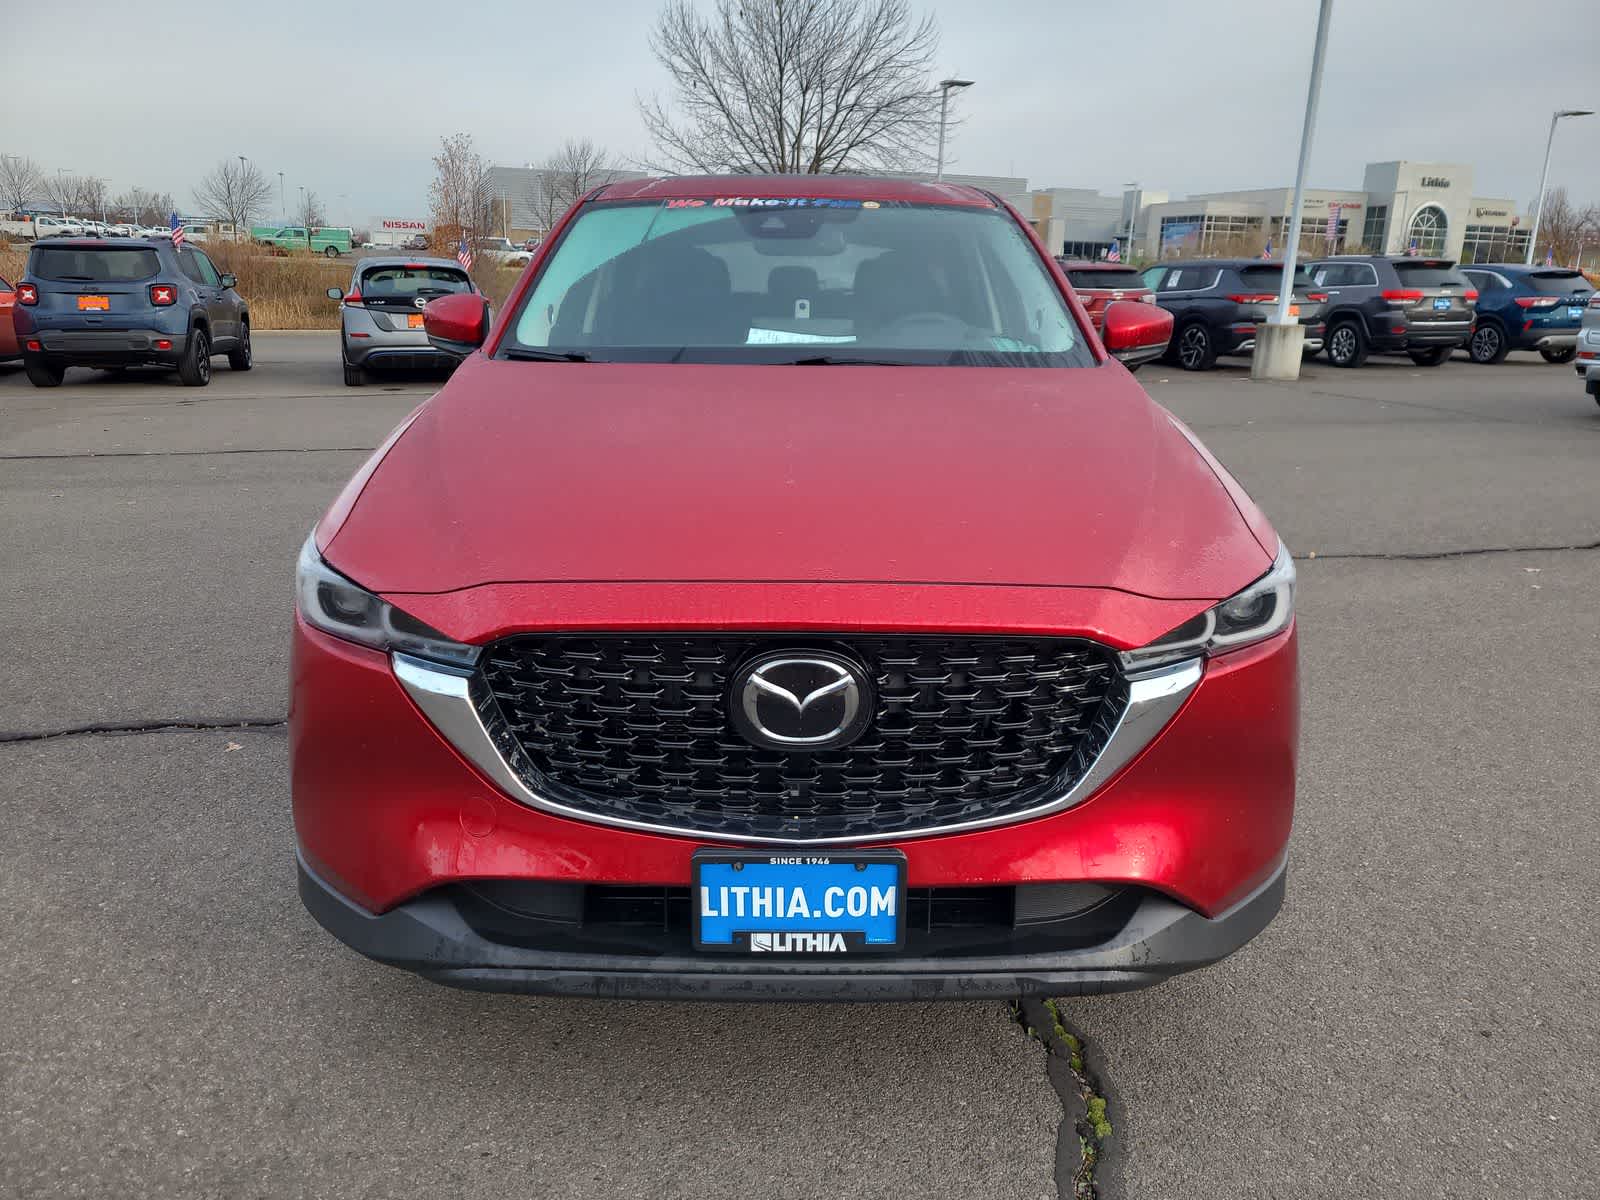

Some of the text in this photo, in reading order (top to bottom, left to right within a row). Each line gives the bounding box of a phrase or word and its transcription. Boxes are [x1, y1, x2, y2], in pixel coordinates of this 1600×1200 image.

[667, 199, 705, 209] We
[712, 197, 781, 207] Make
[383, 220, 426, 229] NISSAN
[770, 857, 830, 865] SINCE 1946
[701, 886, 896, 917] LITHIA.COM
[773, 933, 847, 952] LITHIA
